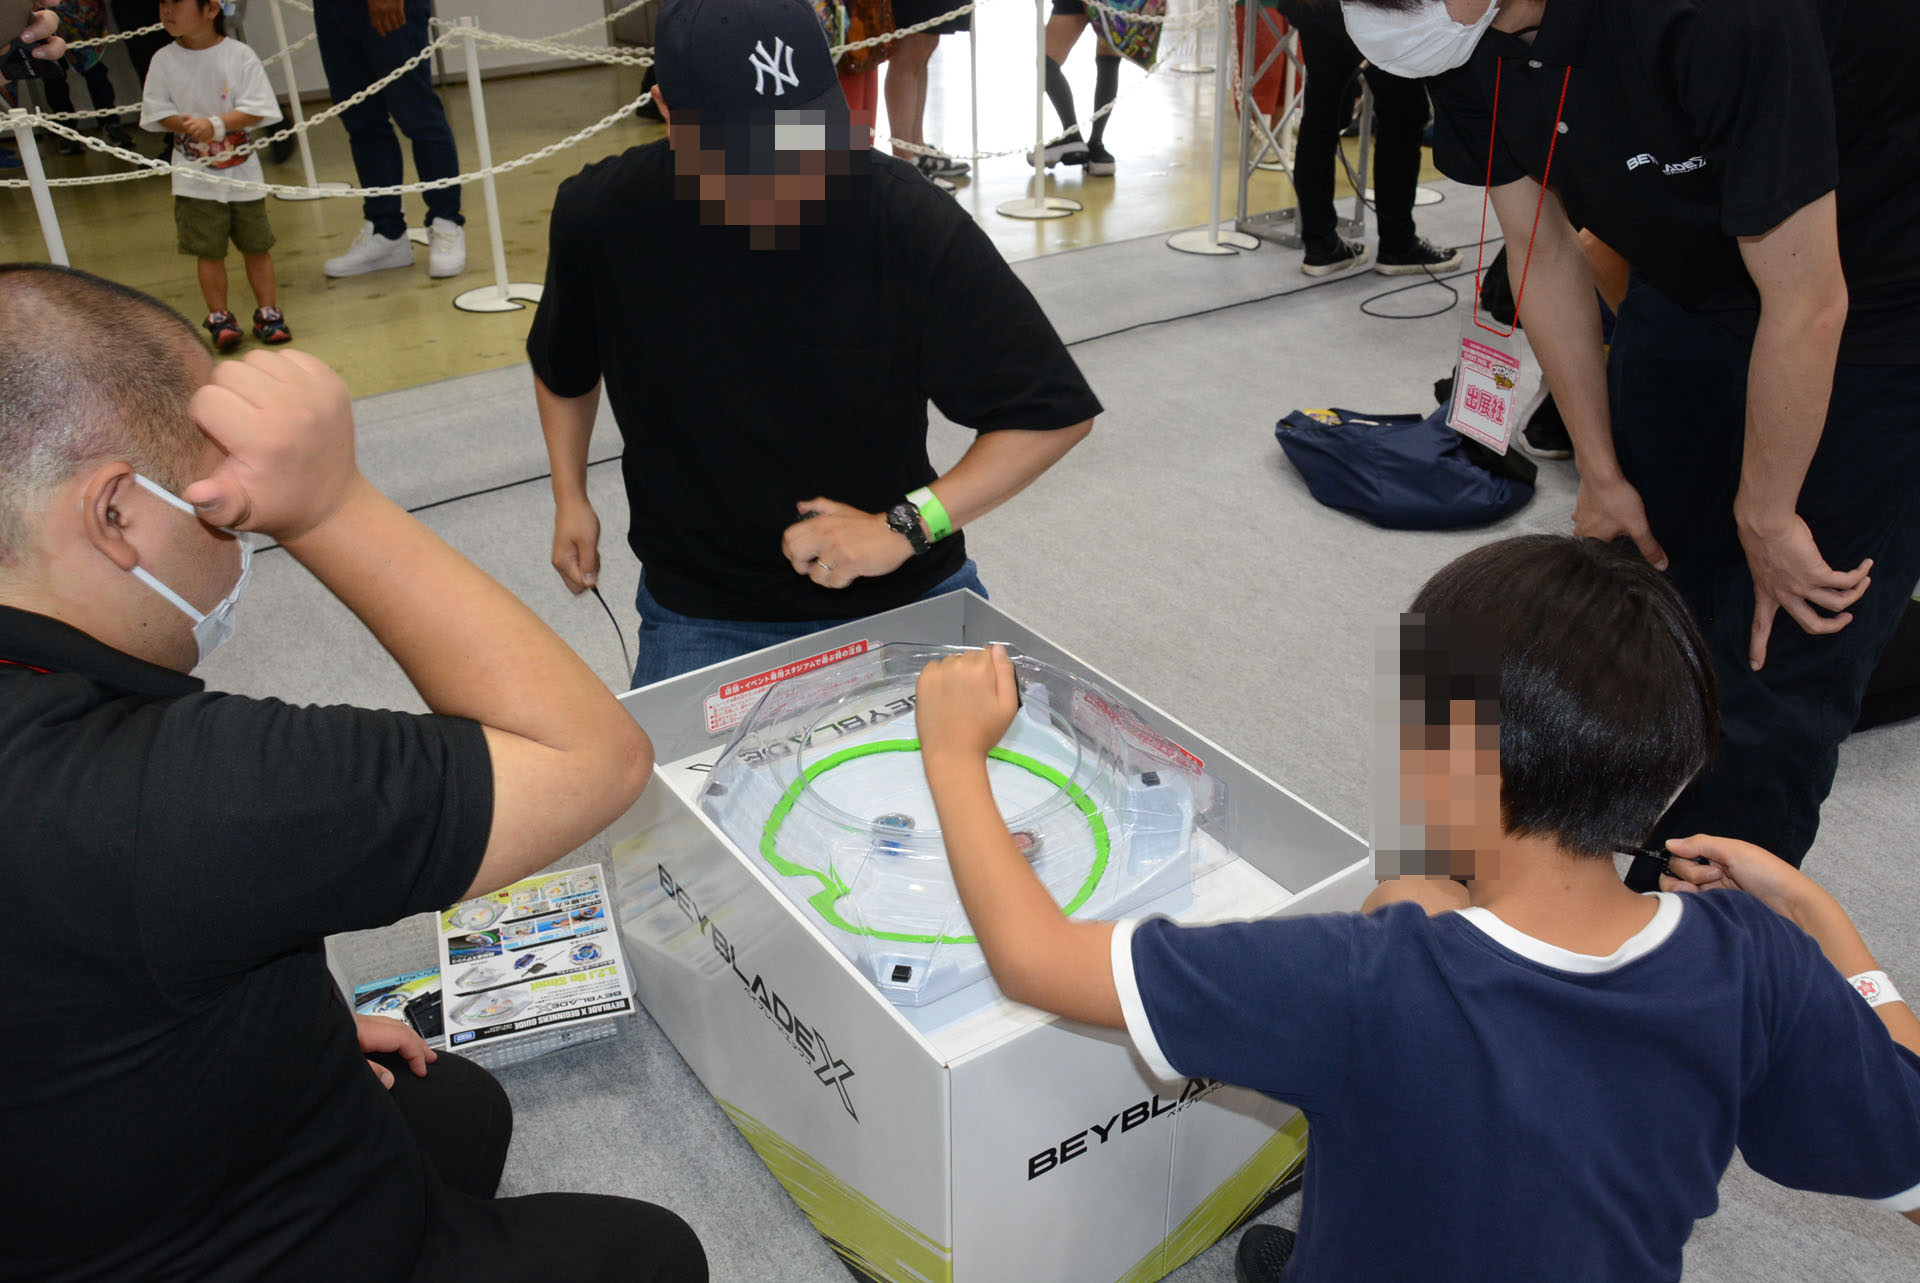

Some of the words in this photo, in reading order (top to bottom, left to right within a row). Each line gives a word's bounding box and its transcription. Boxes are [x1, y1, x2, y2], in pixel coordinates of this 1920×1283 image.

[748, 36, 800, 96] NY
[1464, 384, 1506, 425] 出展社
[589, 1000, 626, 1015] BEYBLADE
[514, 1018, 537, 1030] GUIDE
